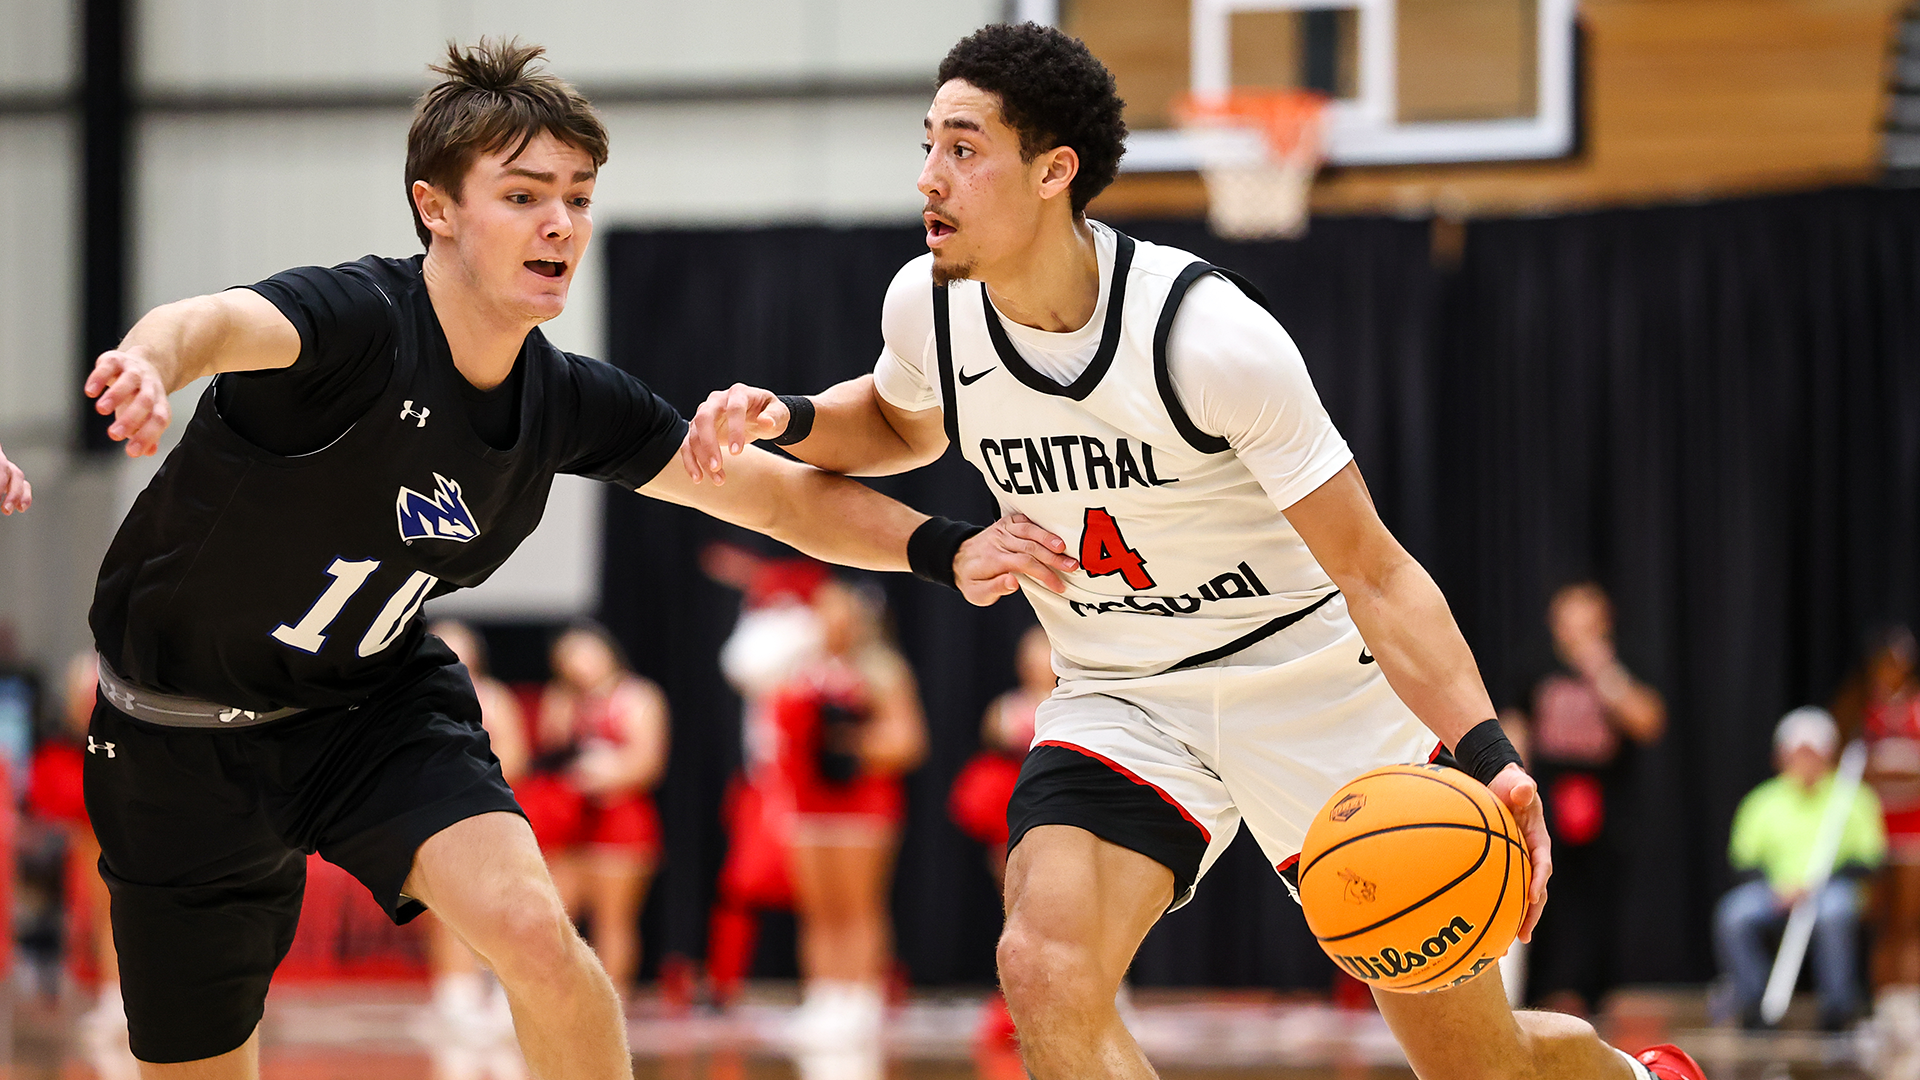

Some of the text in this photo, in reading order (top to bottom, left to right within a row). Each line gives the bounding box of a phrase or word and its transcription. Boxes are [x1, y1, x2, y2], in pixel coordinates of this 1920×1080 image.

[980, 435, 1179, 495] CENTRAL
[1079, 507, 1157, 591] 4
[267, 554, 439, 658] 10
[1334, 915, 1475, 980] Wilson
